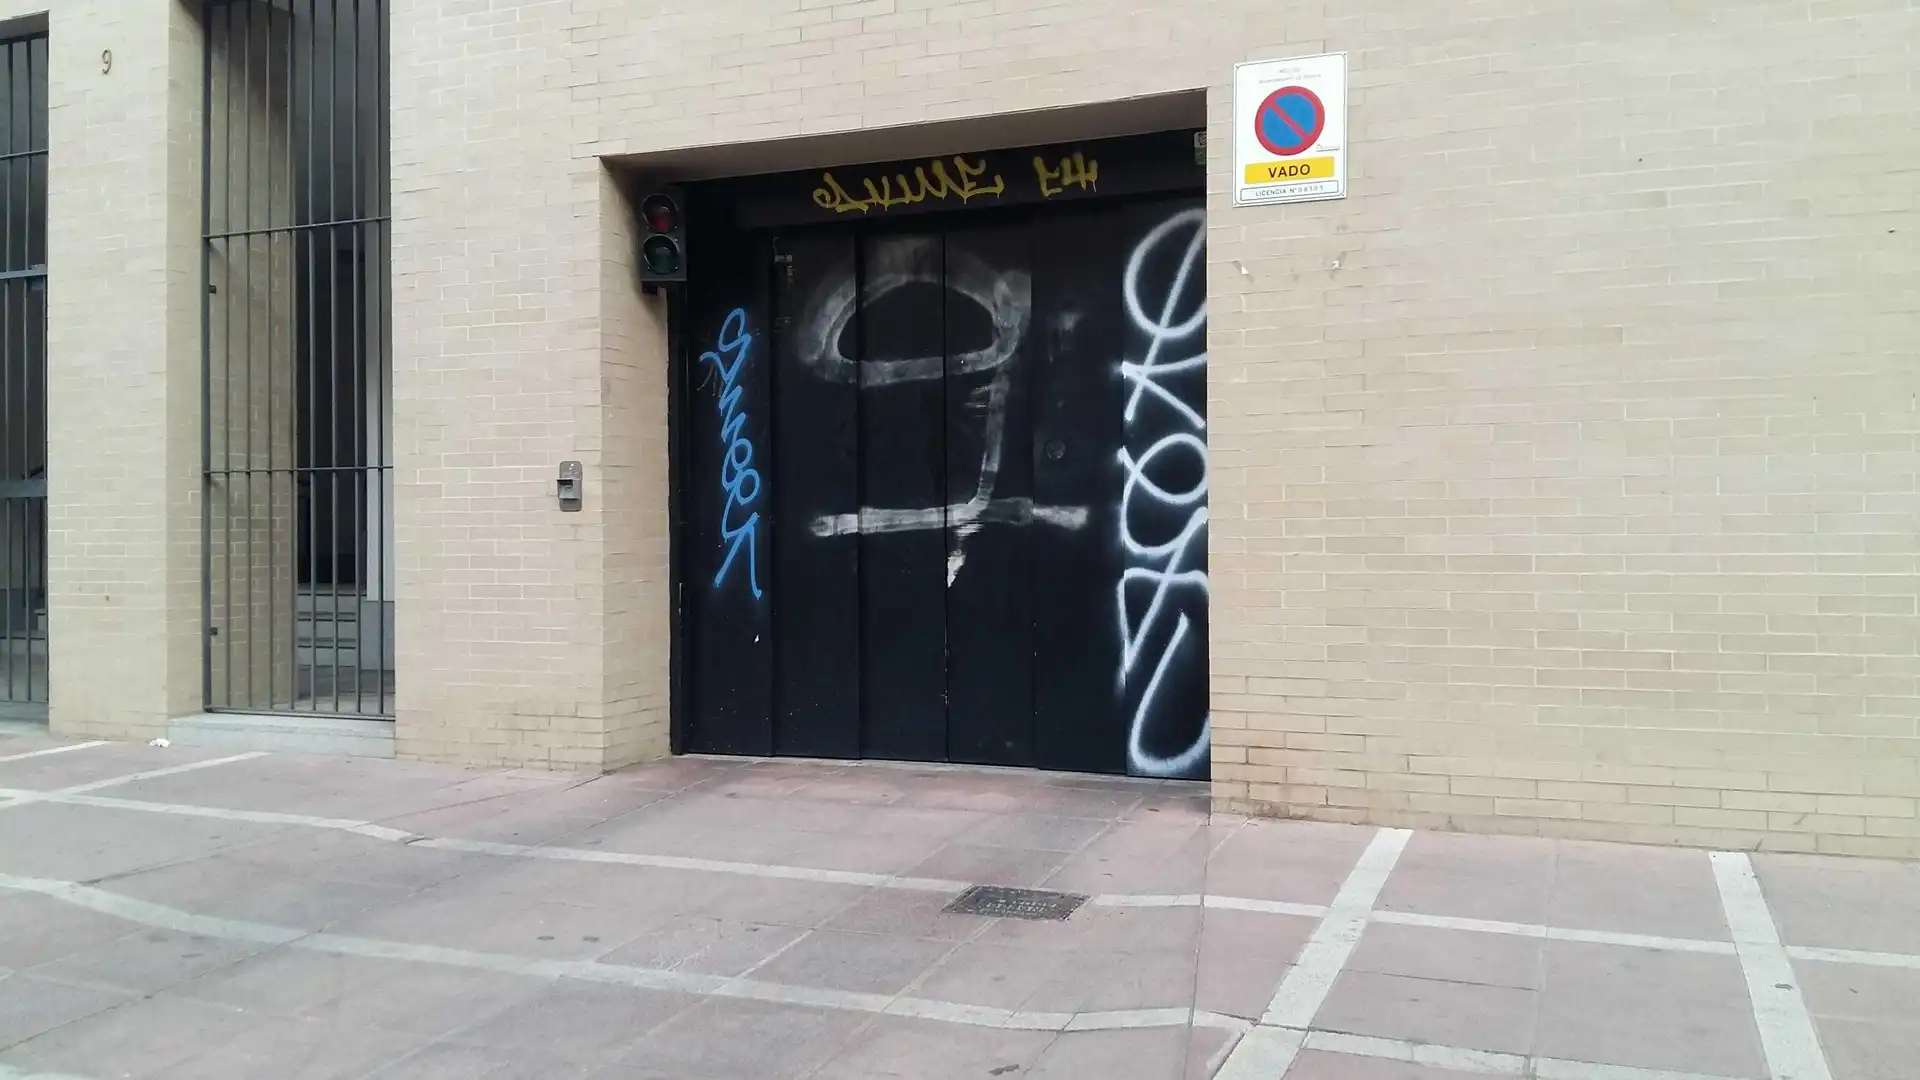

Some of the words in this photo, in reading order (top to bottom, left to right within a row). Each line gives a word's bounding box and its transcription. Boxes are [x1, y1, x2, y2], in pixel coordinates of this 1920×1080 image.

[102, 49, 112, 75] 9
[1268, 164, 1311, 179] VADO
[1255, 188, 1287, 197] LICENCIA
